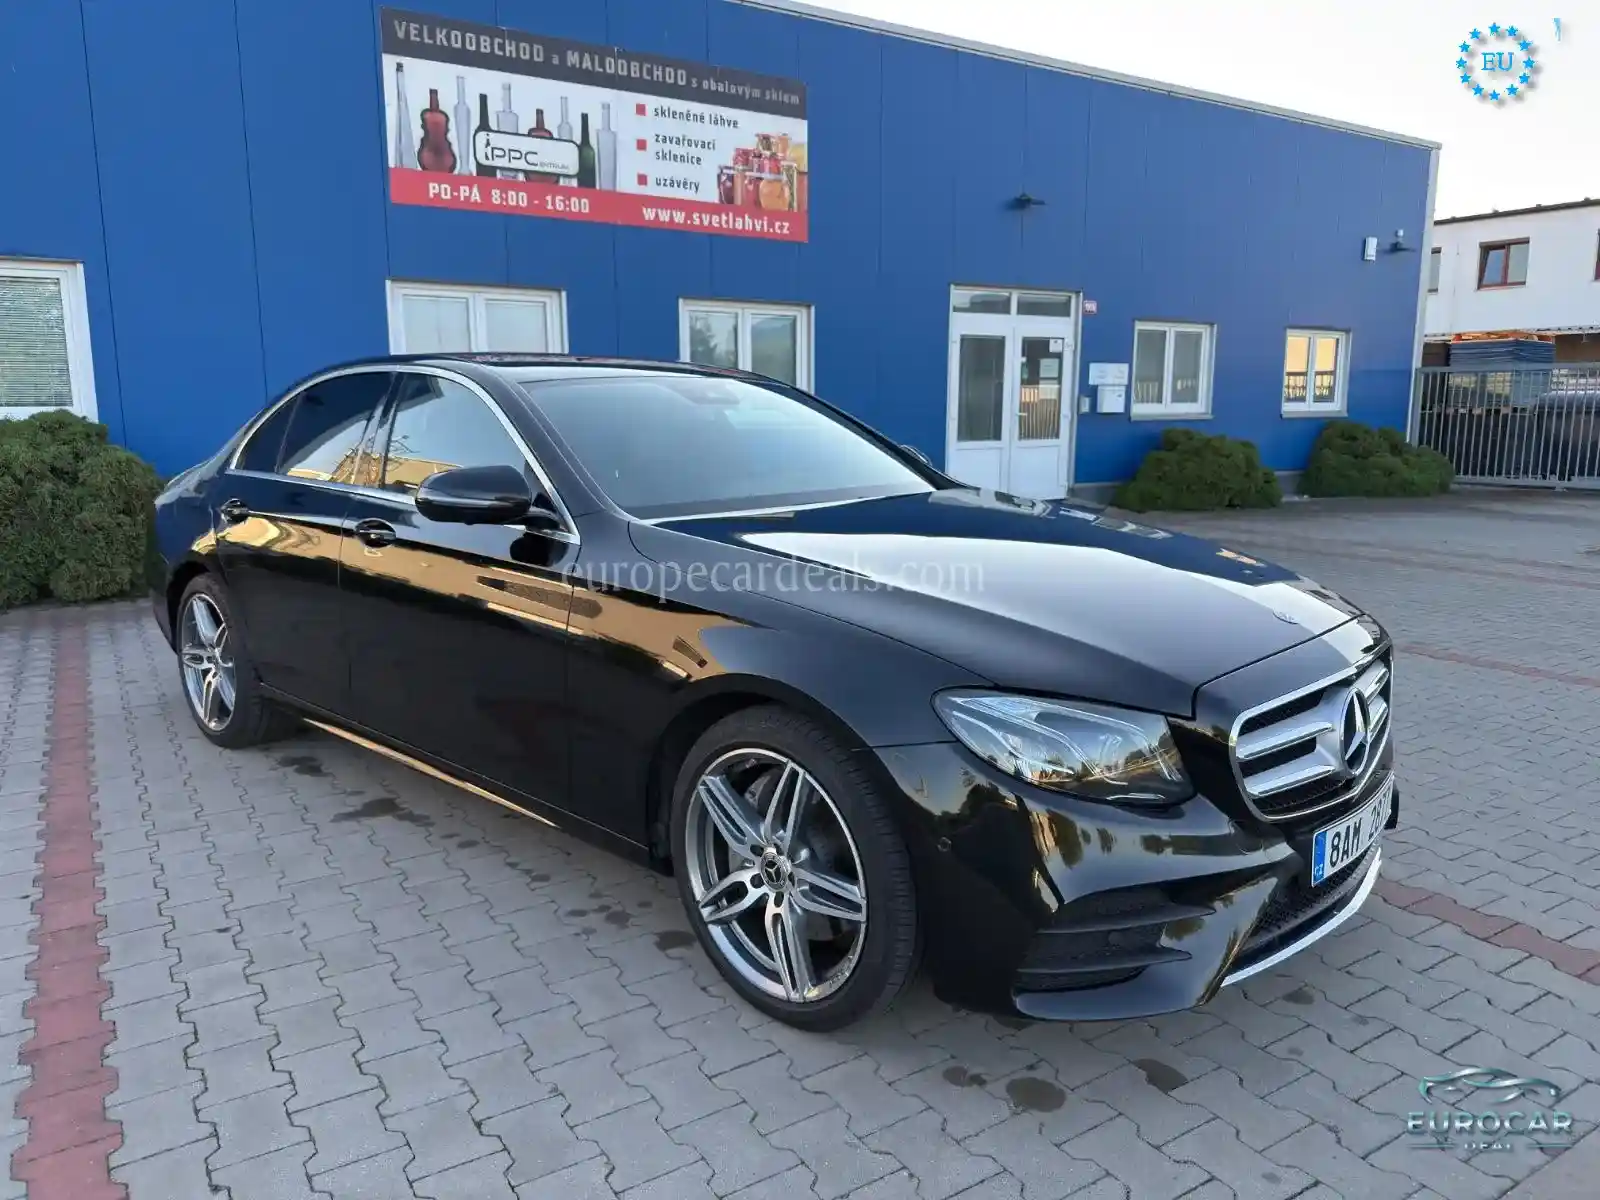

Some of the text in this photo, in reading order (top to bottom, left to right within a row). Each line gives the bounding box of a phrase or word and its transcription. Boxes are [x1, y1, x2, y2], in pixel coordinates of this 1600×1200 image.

[394, 19, 800, 104] VELKOOBCHOD a MALOOBCHOD s obalovým sklem
[654, 105, 739, 129] skleněné láhve
[655, 132, 716, 151] zavařovací
[655, 150, 702, 166] sklenice
[655, 174, 700, 194] uzávěry
[428, 182, 481, 203] PO-PÁ
[491, 188, 527, 208] 8:00
[545, 195, 590, 214] 16:00
[642, 205, 790, 235] www.svetlahvi.cz
[1329, 817, 1362, 868] 8AM
